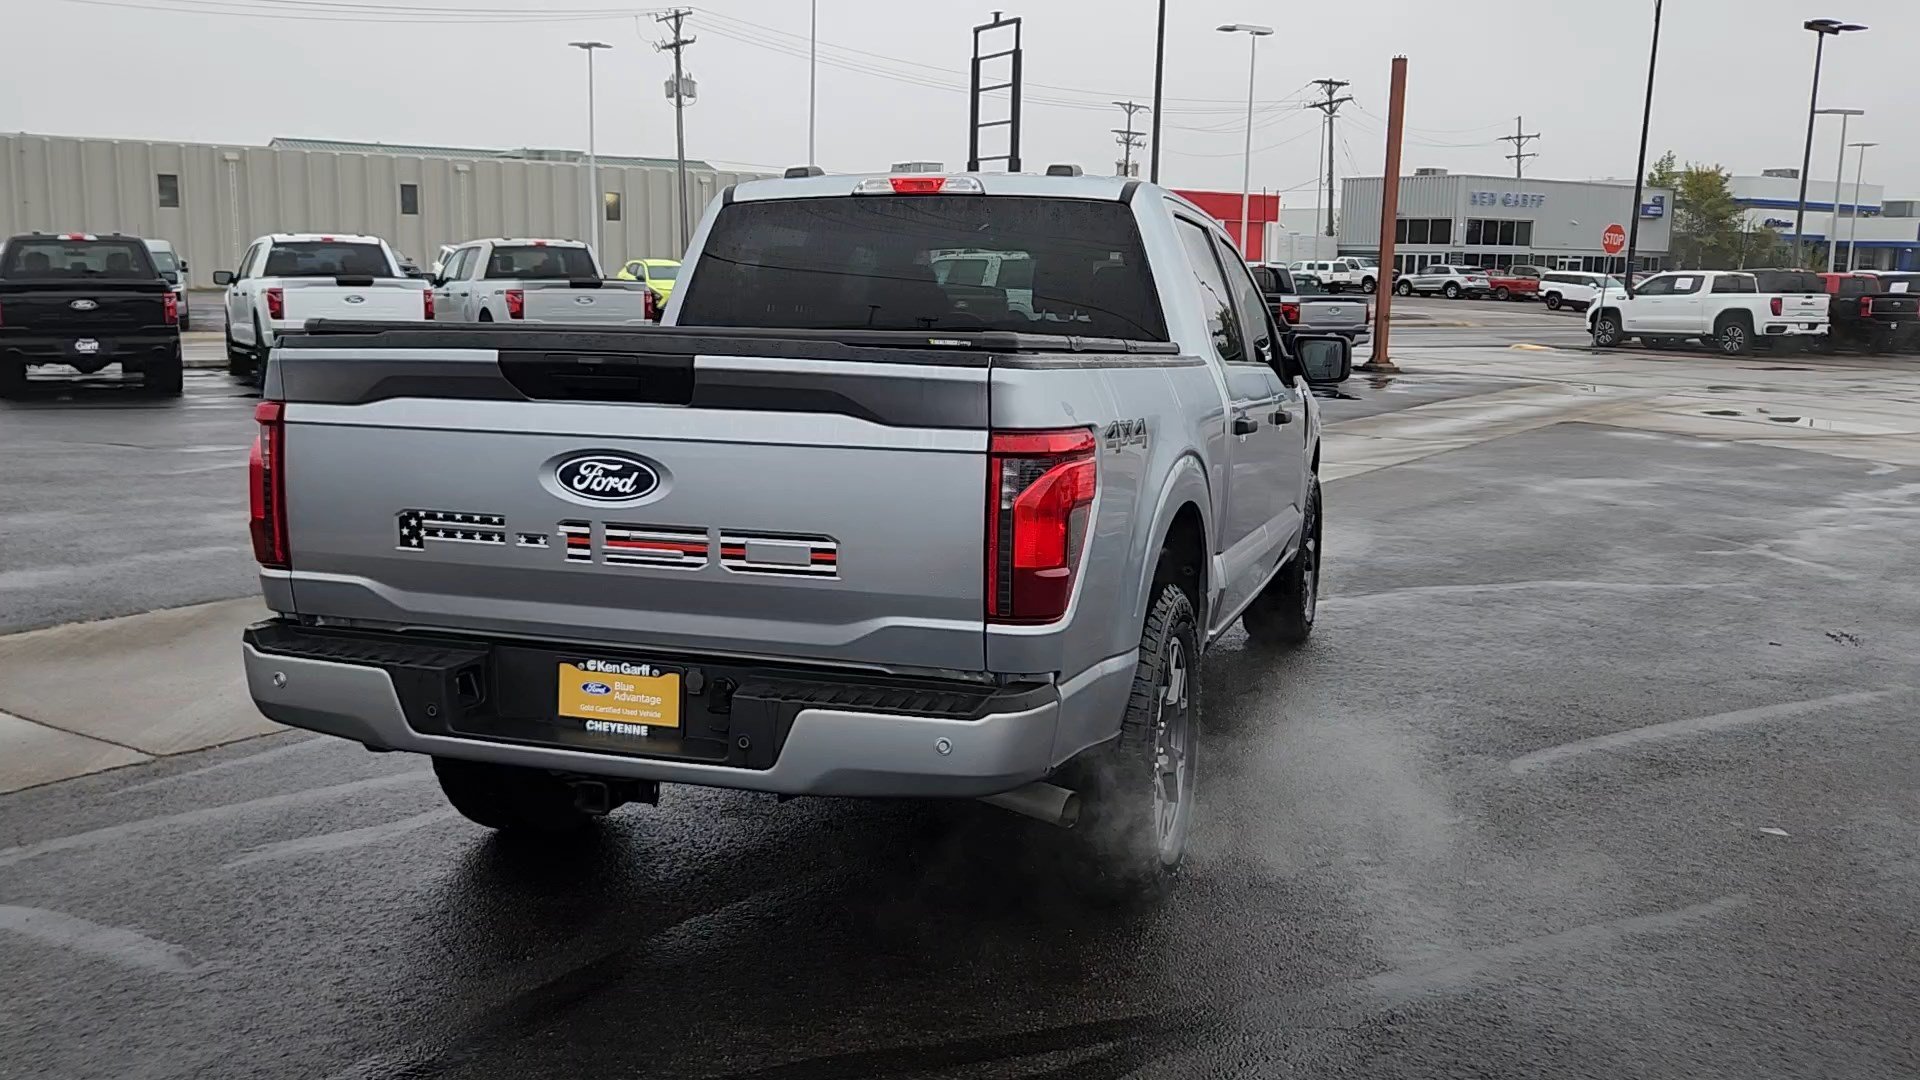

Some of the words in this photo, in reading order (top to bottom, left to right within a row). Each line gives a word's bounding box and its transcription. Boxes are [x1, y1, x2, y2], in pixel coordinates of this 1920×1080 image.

[1604, 233, 1624, 245] STOP
[572, 462, 639, 493] Ford
[395, 508, 841, 581] F-150
[596, 660, 620, 673] Ken
[620, 662, 651, 676] Garff
[586, 682, 607, 694] Ford
[614, 681, 635, 692] Blue
[614, 692, 661, 705] Advantage
[580, 704, 595, 712] Gold
[595, 705, 621, 714] Certified
[621, 708, 638, 716] Used
[639, 710, 662, 718] Vehicle
[586, 720, 648, 735] CHEYENNE
